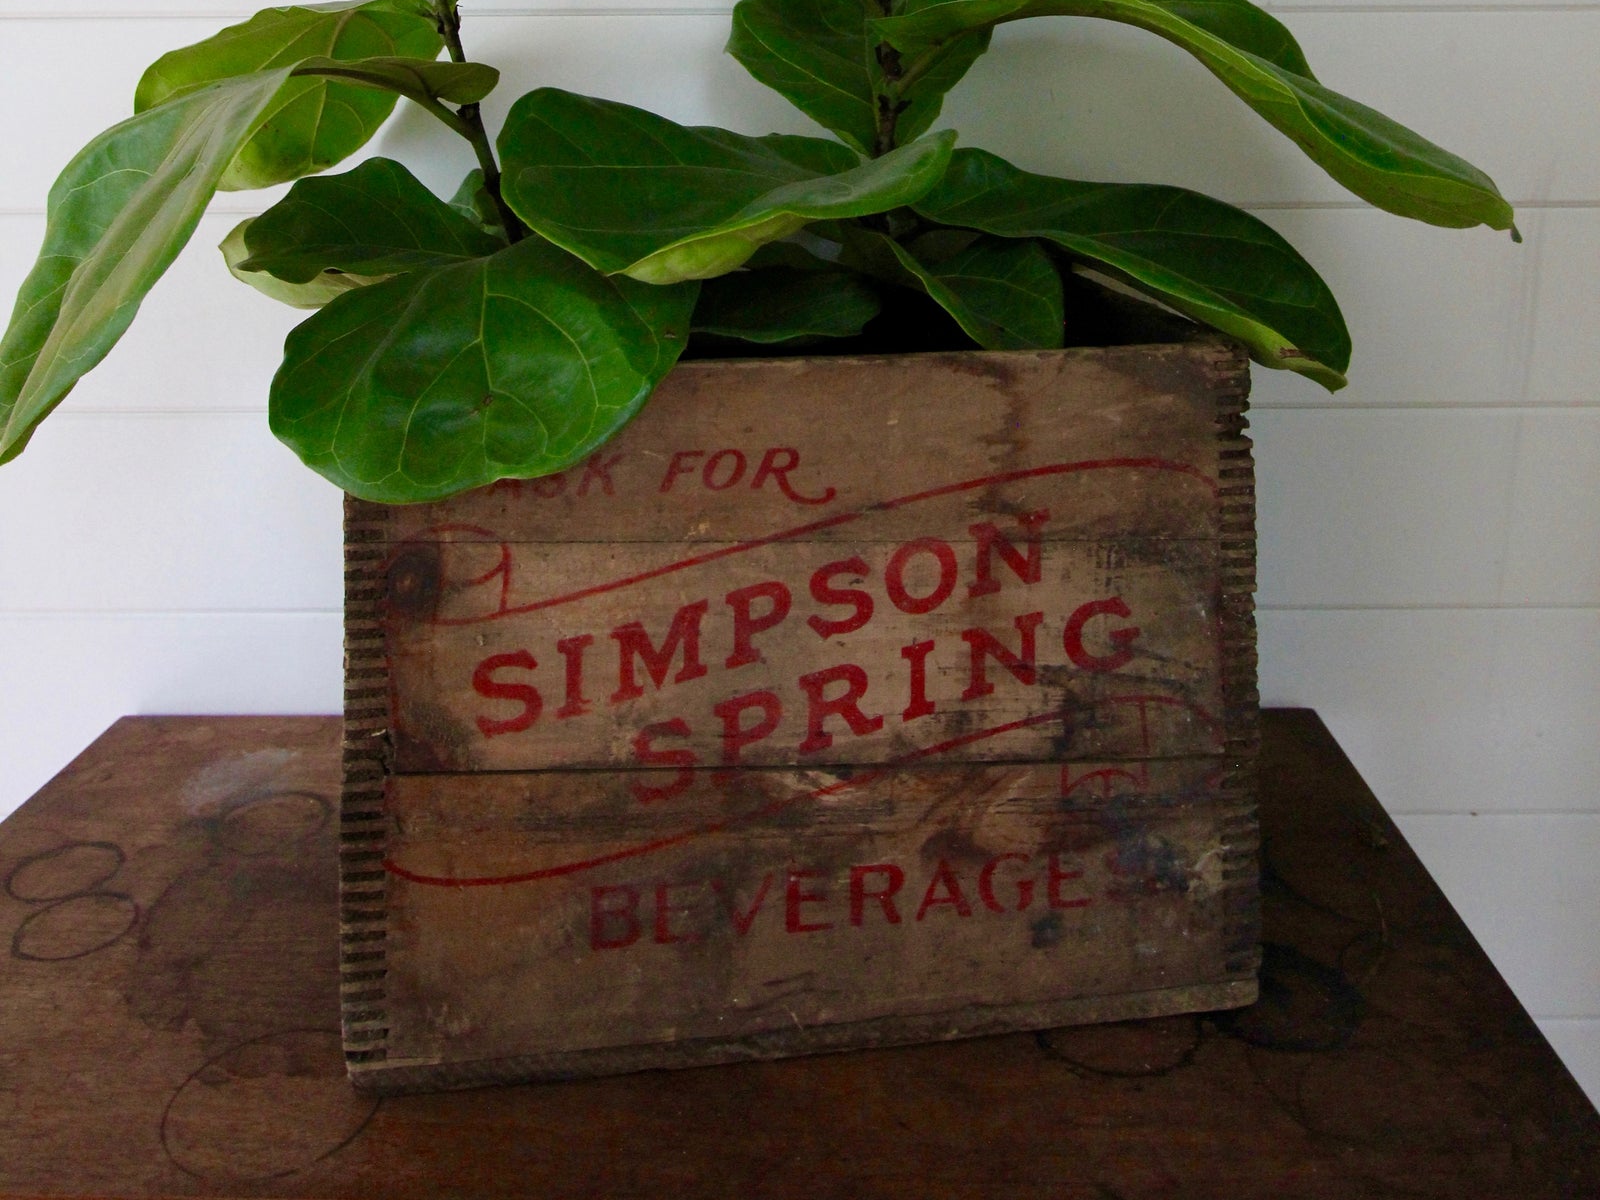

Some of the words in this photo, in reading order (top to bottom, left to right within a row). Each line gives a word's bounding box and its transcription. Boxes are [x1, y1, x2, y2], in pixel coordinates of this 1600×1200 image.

[659, 447, 837, 506] FOR
[471, 508, 1051, 738] SIMPSON
[629, 596, 1141, 801] SPRING
